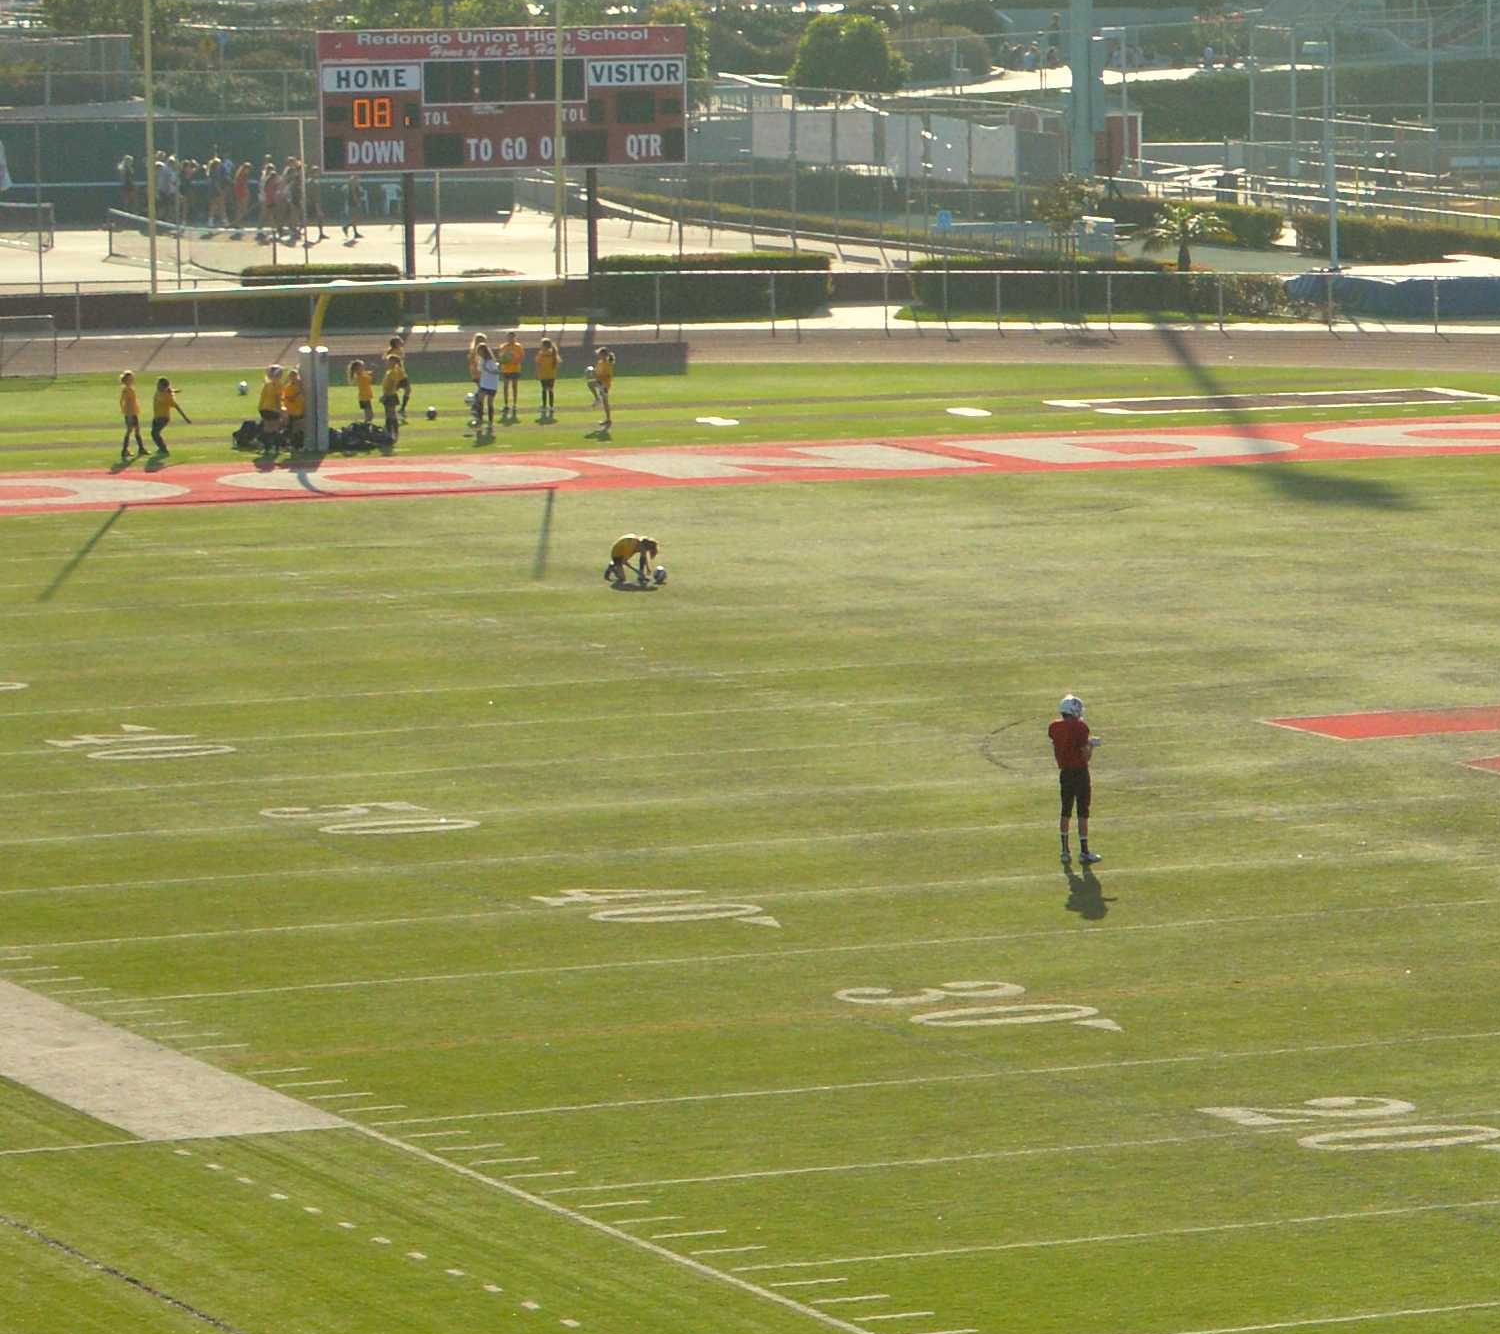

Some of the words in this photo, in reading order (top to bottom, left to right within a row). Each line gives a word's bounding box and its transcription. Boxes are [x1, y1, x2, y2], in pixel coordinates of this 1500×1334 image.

[357, 32, 451, 46] Redondo
[457, 30, 517, 44] Union
[525, 29, 571, 45] High
[577, 28, 649, 42] School
[483, 44, 502, 57] the
[534, 42, 577, 56] Haks
[336, 69, 406, 89] HOME
[591, 63, 680, 83] VISITOR
[353, 98, 392, 129] 08
[424, 112, 450, 126] TOL
[561, 108, 588, 122] TOL
[347, 140, 405, 164] DOWN
[467, 138, 493, 162] TO
[501, 136, 528, 161] GO
[626, 134, 662, 161] QTR
[259, 801, 481, 835] 50
[531, 888, 763, 923] 40
[834, 981, 1100, 1027] 30
